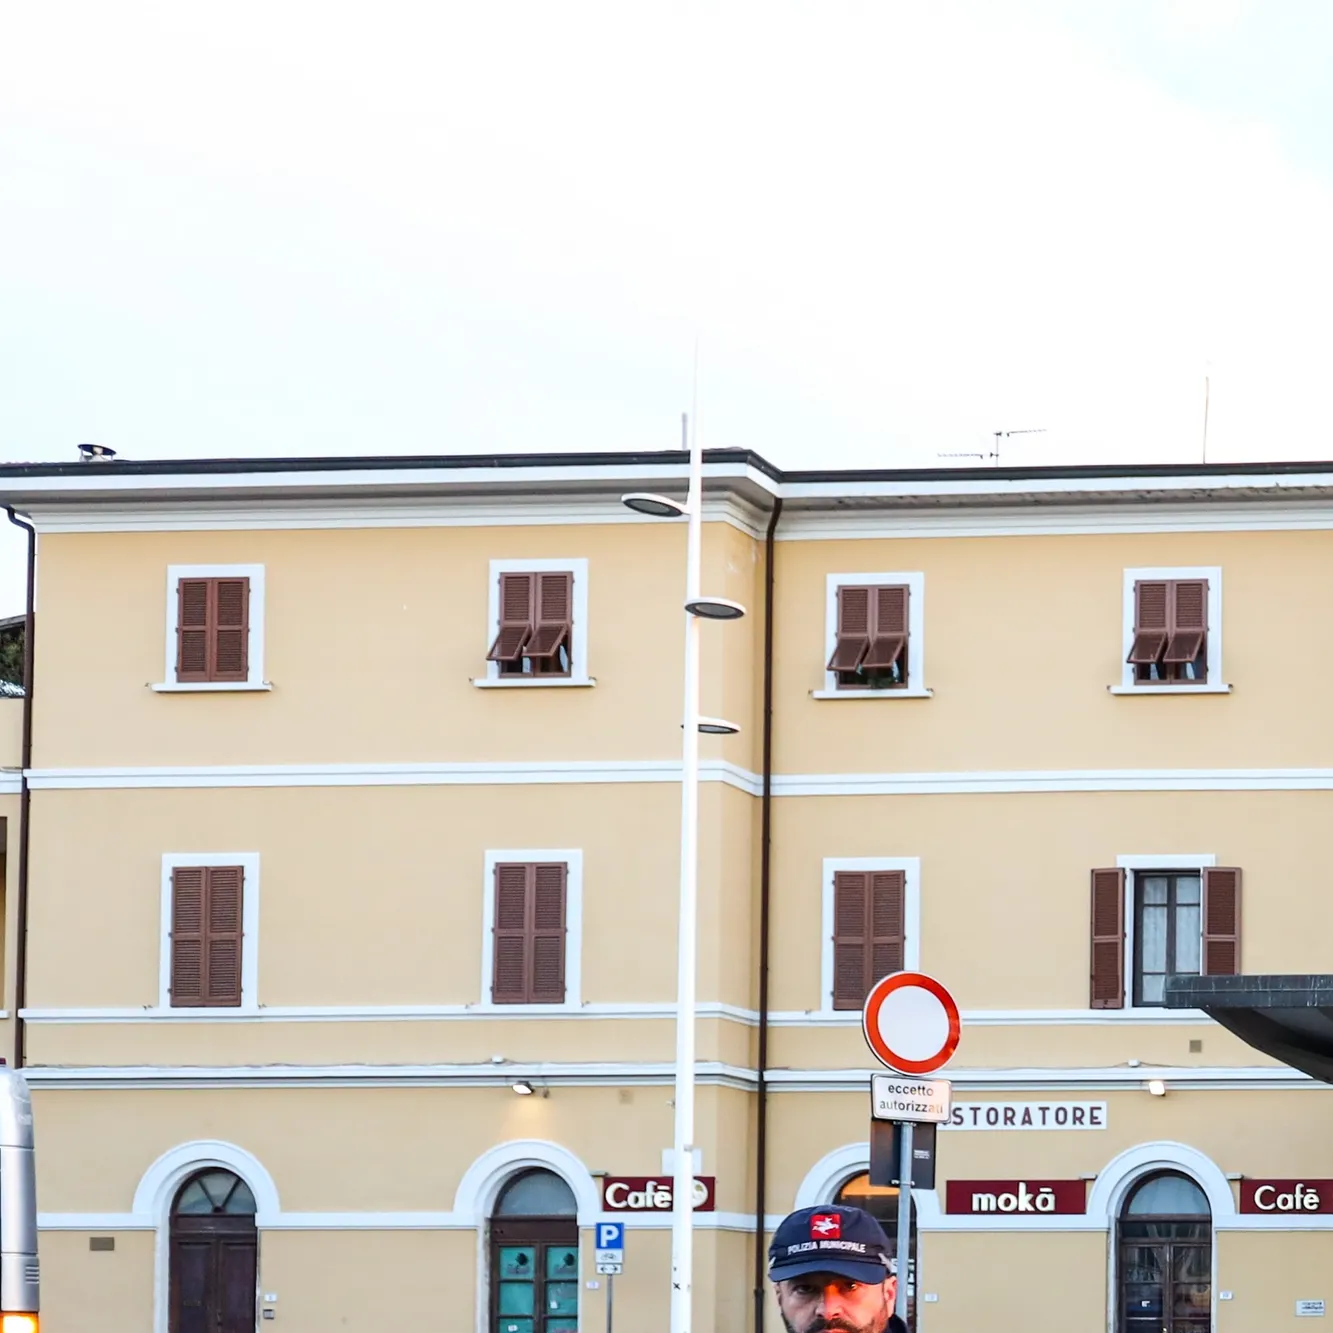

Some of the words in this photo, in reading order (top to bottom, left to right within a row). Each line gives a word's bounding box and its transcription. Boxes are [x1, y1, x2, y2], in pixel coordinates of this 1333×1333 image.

[888, 1084, 934, 1097] eccetto
[879, 1100, 943, 1114] autorizzati
[942, 1106, 1102, 1126] STORATORE
[600, 1225, 619, 1248] P
[787, 1241, 818, 1256] POLIZIA
[819, 1240, 866, 1253] MUNICIPALE
